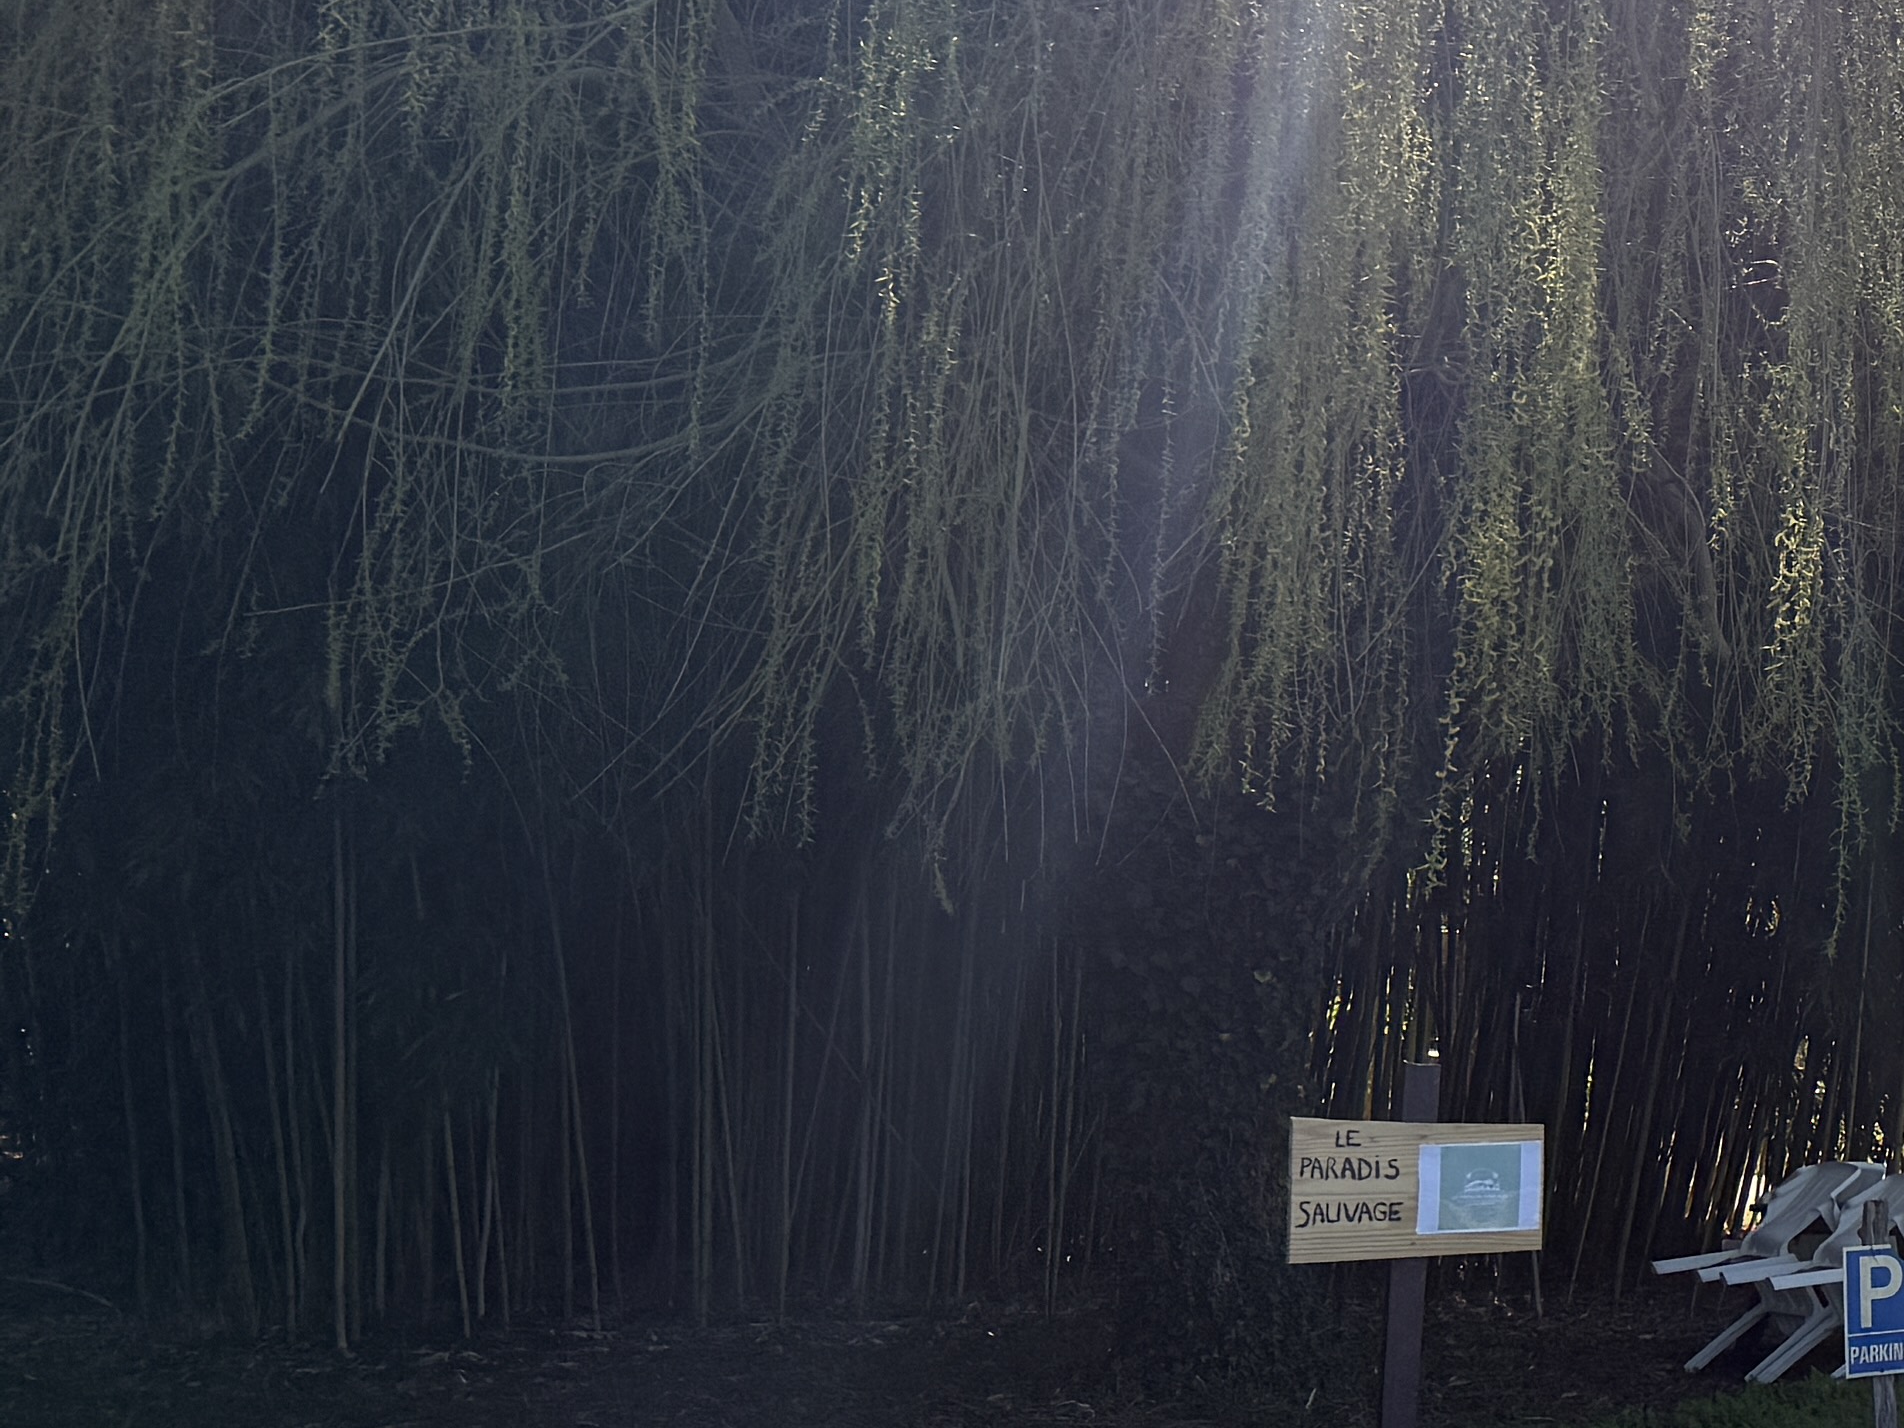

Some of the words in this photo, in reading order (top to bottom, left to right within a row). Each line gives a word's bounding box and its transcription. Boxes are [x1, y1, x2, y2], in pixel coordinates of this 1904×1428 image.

[1335, 1130, 1361, 1147] LE
[1295, 1201, 1404, 1228] SAUVAGE
[1859, 1255, 1903, 1328] P
